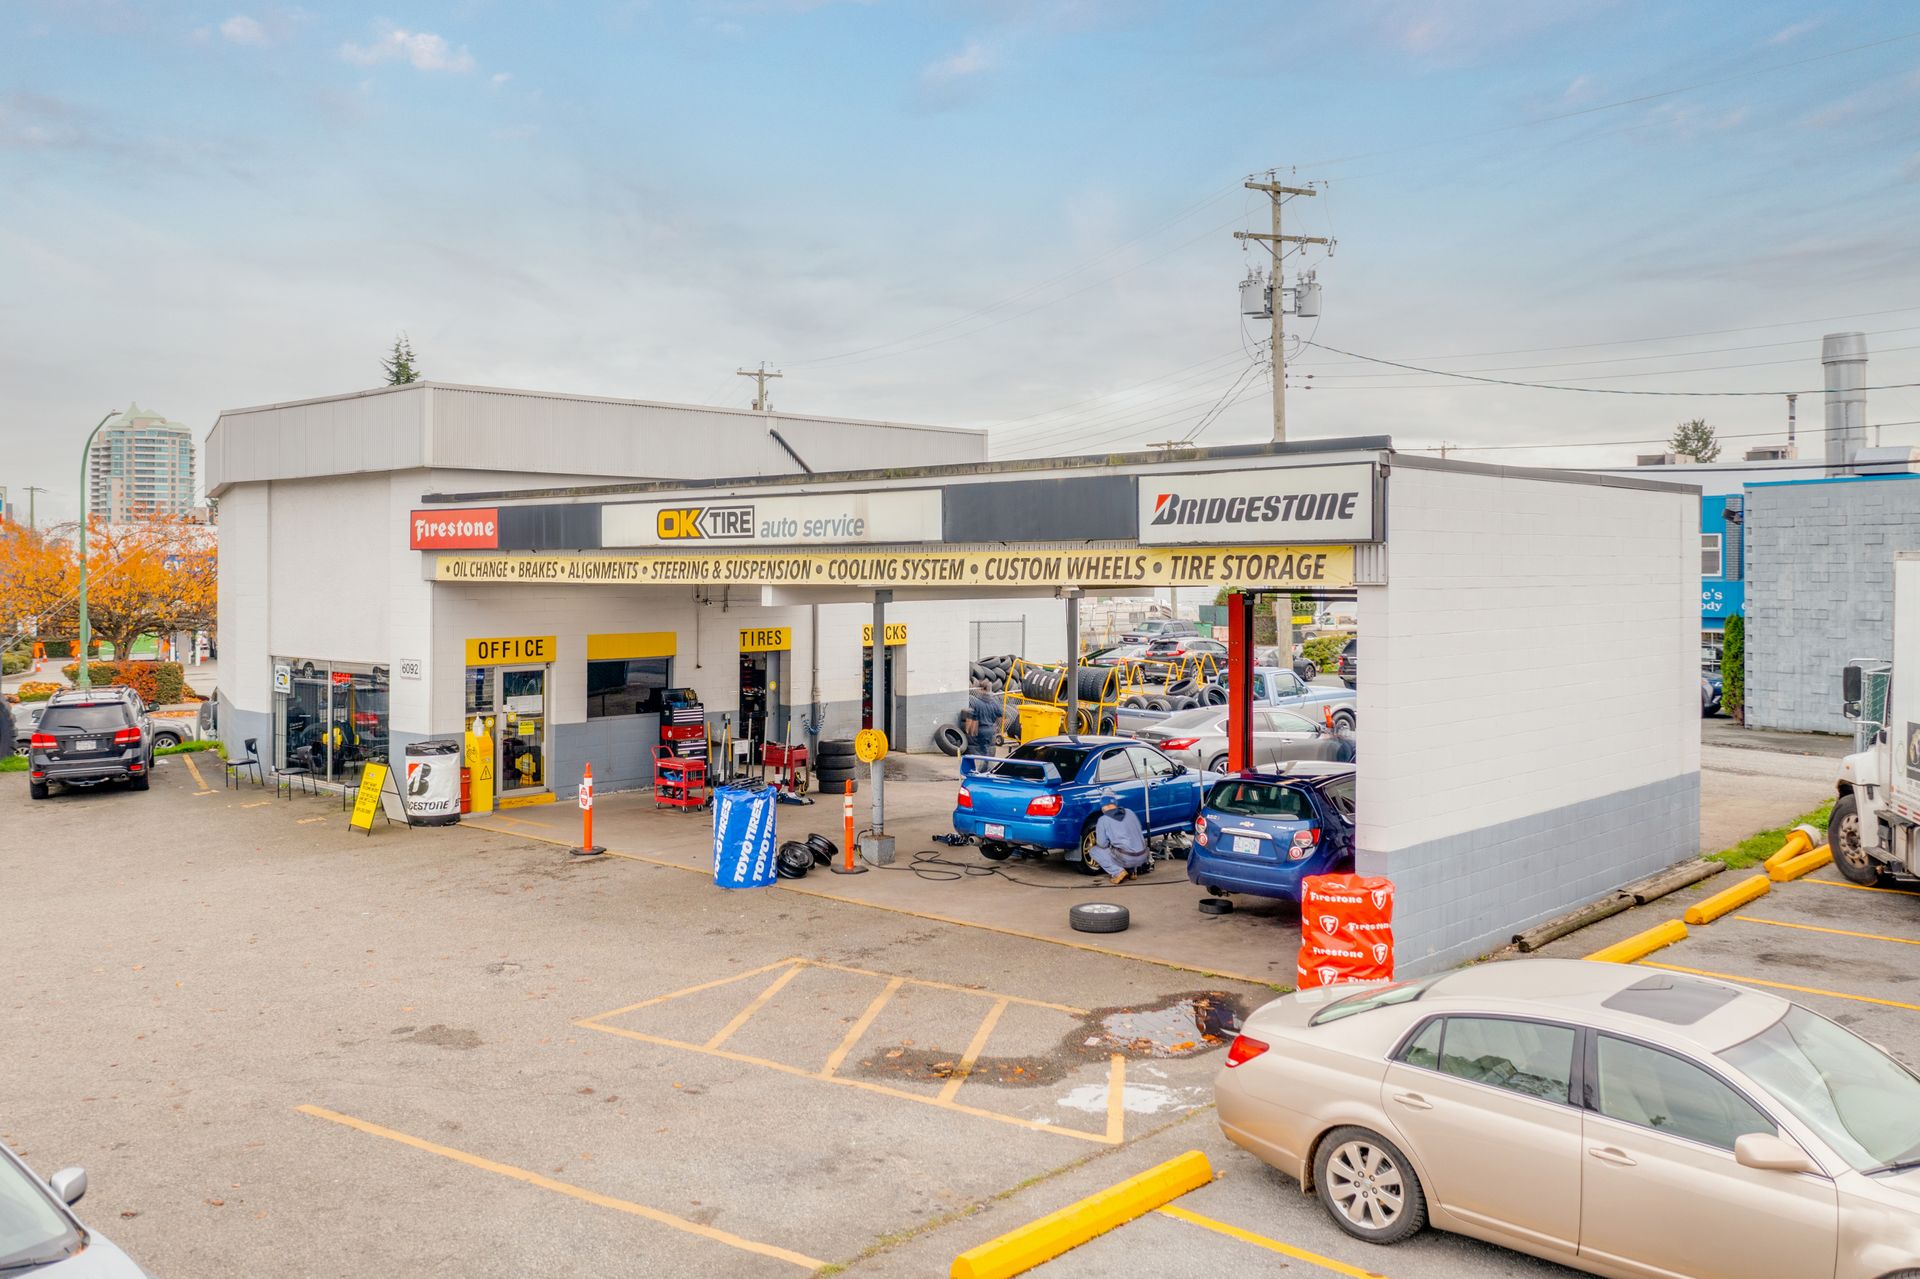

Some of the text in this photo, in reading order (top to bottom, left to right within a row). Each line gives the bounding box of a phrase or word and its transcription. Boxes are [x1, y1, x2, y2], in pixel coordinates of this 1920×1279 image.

[1151, 492, 1359, 525] BRIDGESTONE
[415, 519, 495, 541] Firestone
[657, 509, 751, 539] OK TIRE
[760, 513, 865, 538] auto service
[453, 561, 508, 579] OIL CHANGE
[518, 561, 558, 579] BRAKES
[568, 561, 639, 580] ALIGNMENTS
[651, 559, 812, 580] STEERING & SUSPENSION
[828, 558, 965, 580] COOLING SYSTEM
[984, 556, 1147, 580] CUSTOM WHEELS
[1170, 554, 1327, 580] TIRE STORAGE
[740, 630, 782, 647] TIRES
[863, 625, 907, 642] SCKS
[478, 639, 544, 659] OFFICE
[401, 663, 419, 675] 6092
[1310, 891, 1363, 904] Firestone
[1312, 946, 1364, 959] Firestone
